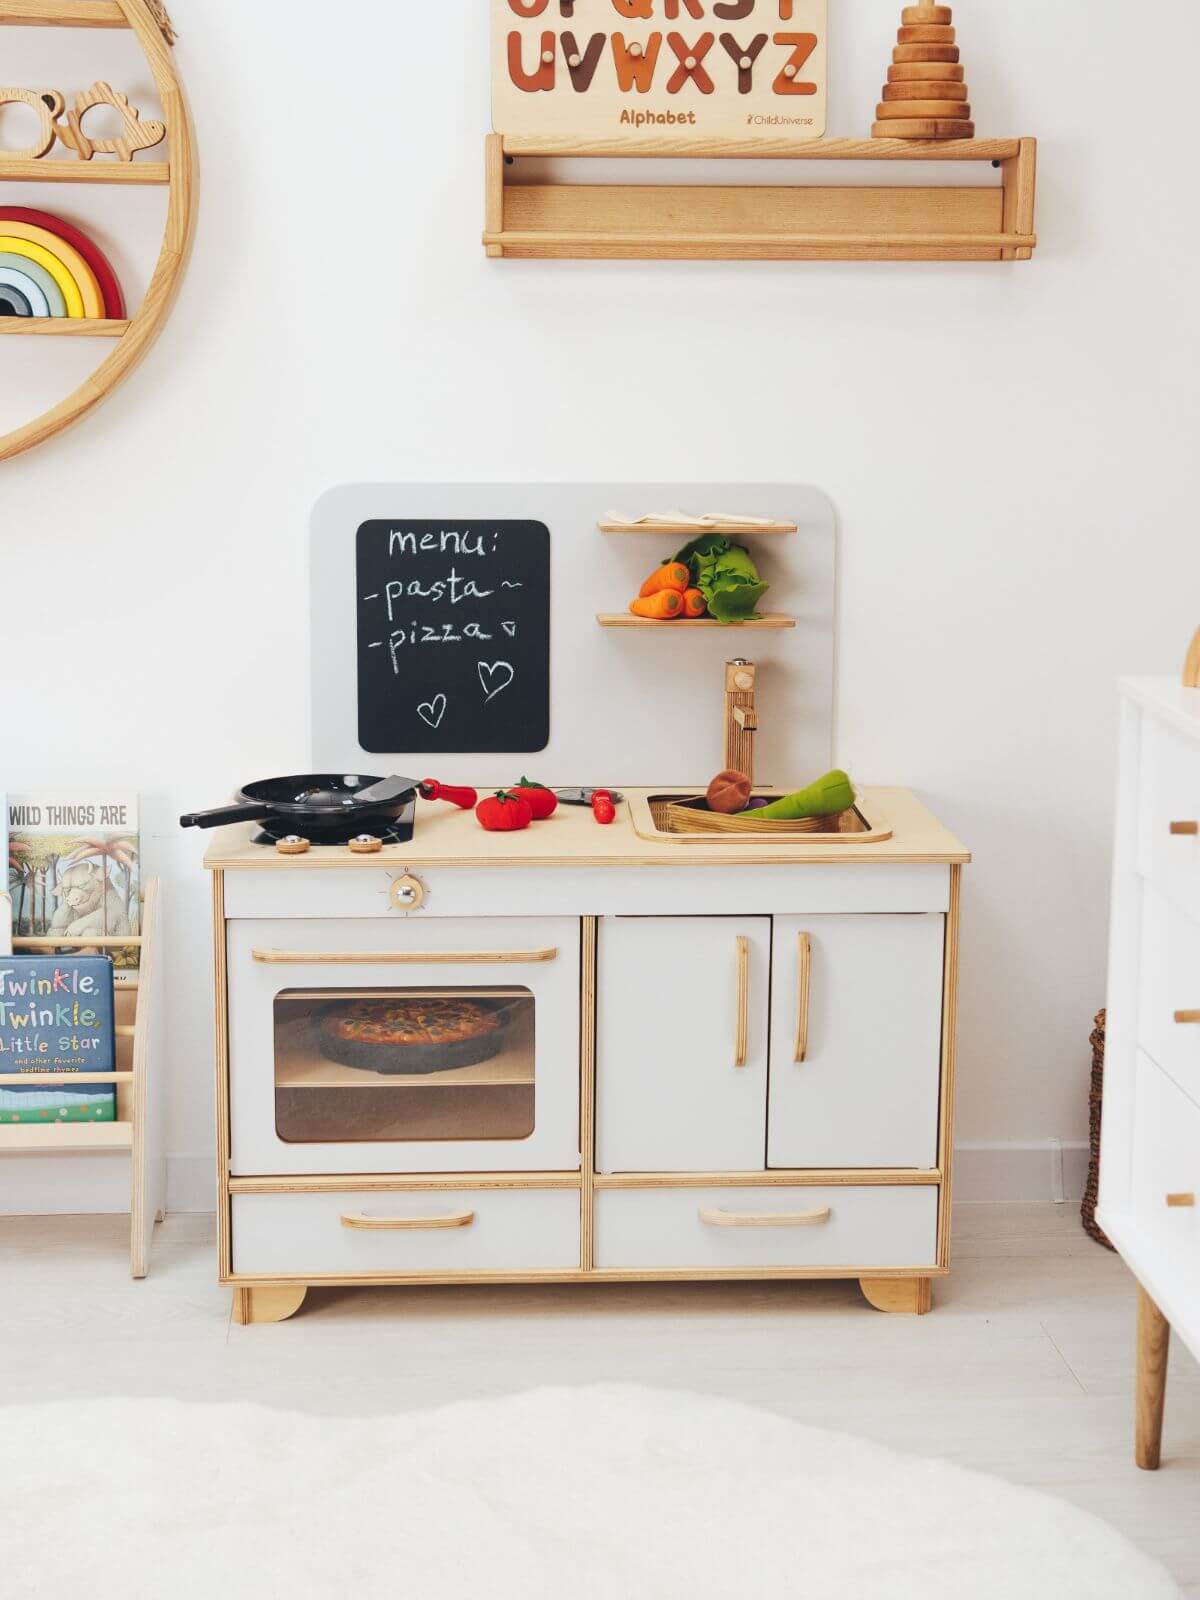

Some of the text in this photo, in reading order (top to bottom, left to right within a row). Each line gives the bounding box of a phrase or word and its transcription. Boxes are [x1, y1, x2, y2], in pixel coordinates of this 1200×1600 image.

[619, 109, 696, 128] Alphabet
[753, 114, 814, 126] ChildUniverse
[388, 529, 498, 556] menu:
[9, 805, 127, 826] WILD THINGS ARE
